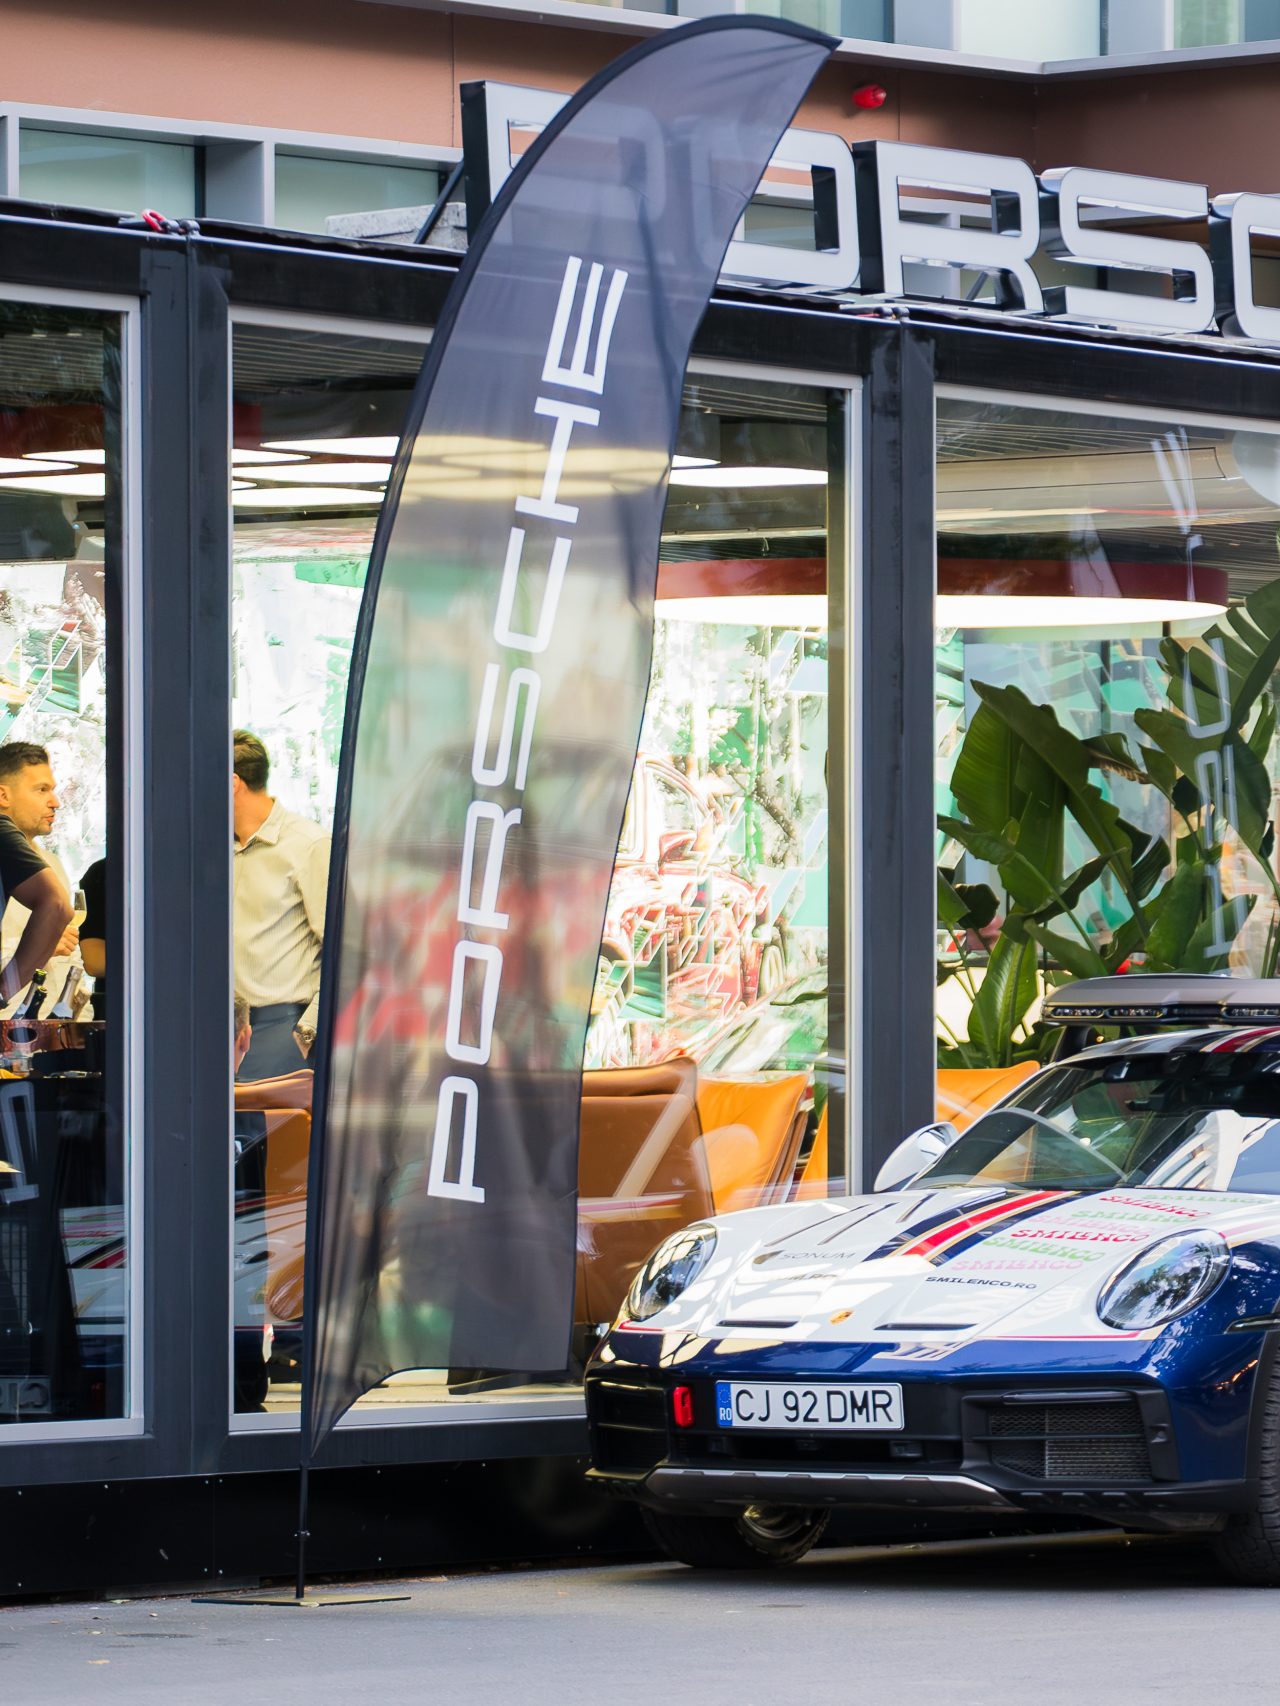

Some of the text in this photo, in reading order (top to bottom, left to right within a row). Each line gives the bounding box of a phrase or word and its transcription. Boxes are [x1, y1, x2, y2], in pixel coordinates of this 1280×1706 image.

[427, 256, 628, 1203] PORSCHE
[925, 1276, 1038, 1290] SMILENCO.RO
[719, 1407, 732, 1421] RO
[735, 1389, 894, 1423] CJ 92 DMR
